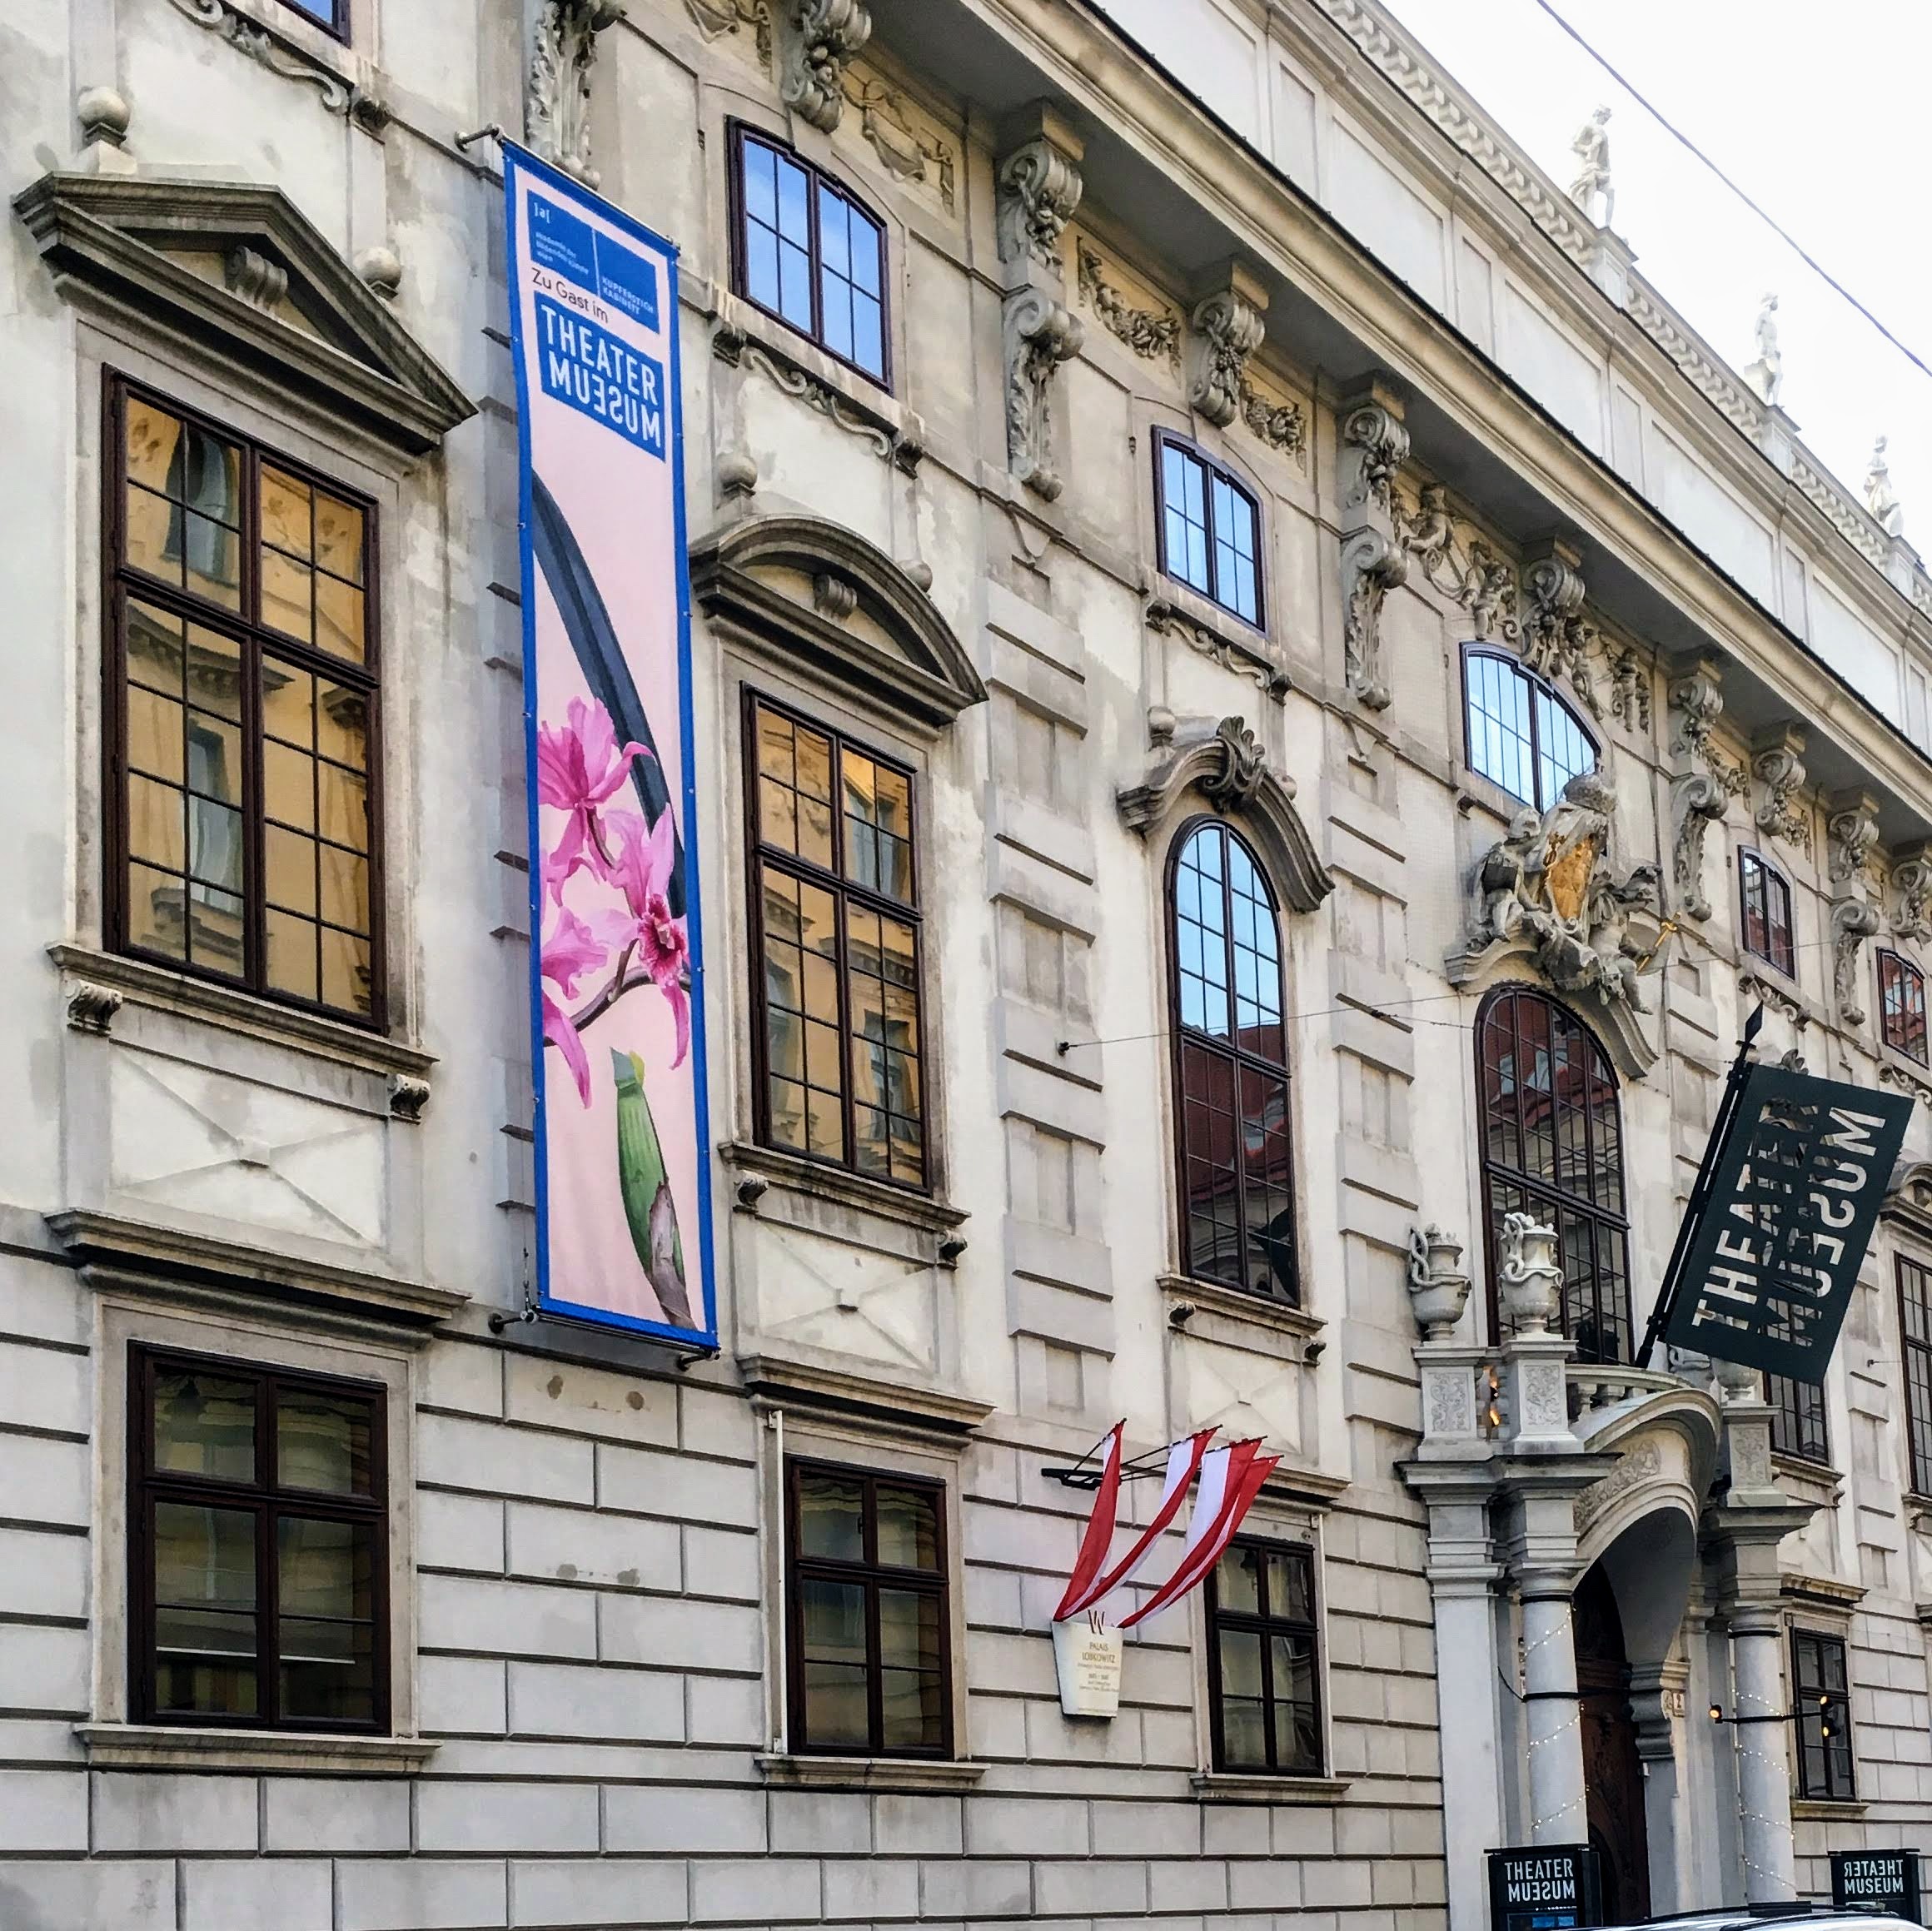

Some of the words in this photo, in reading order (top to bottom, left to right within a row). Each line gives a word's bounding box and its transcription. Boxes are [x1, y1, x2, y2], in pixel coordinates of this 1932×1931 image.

[531, 267, 552, 289] Zu
[555, 281, 589, 311] Gast
[592, 301, 609, 324] im
[541, 304, 659, 406] THEATER
[1691, 1097, 1819, 1331] THEATER
[1504, 1858, 1574, 1881] THEATER
[1844, 1876, 1904, 1894] MUSEUM
